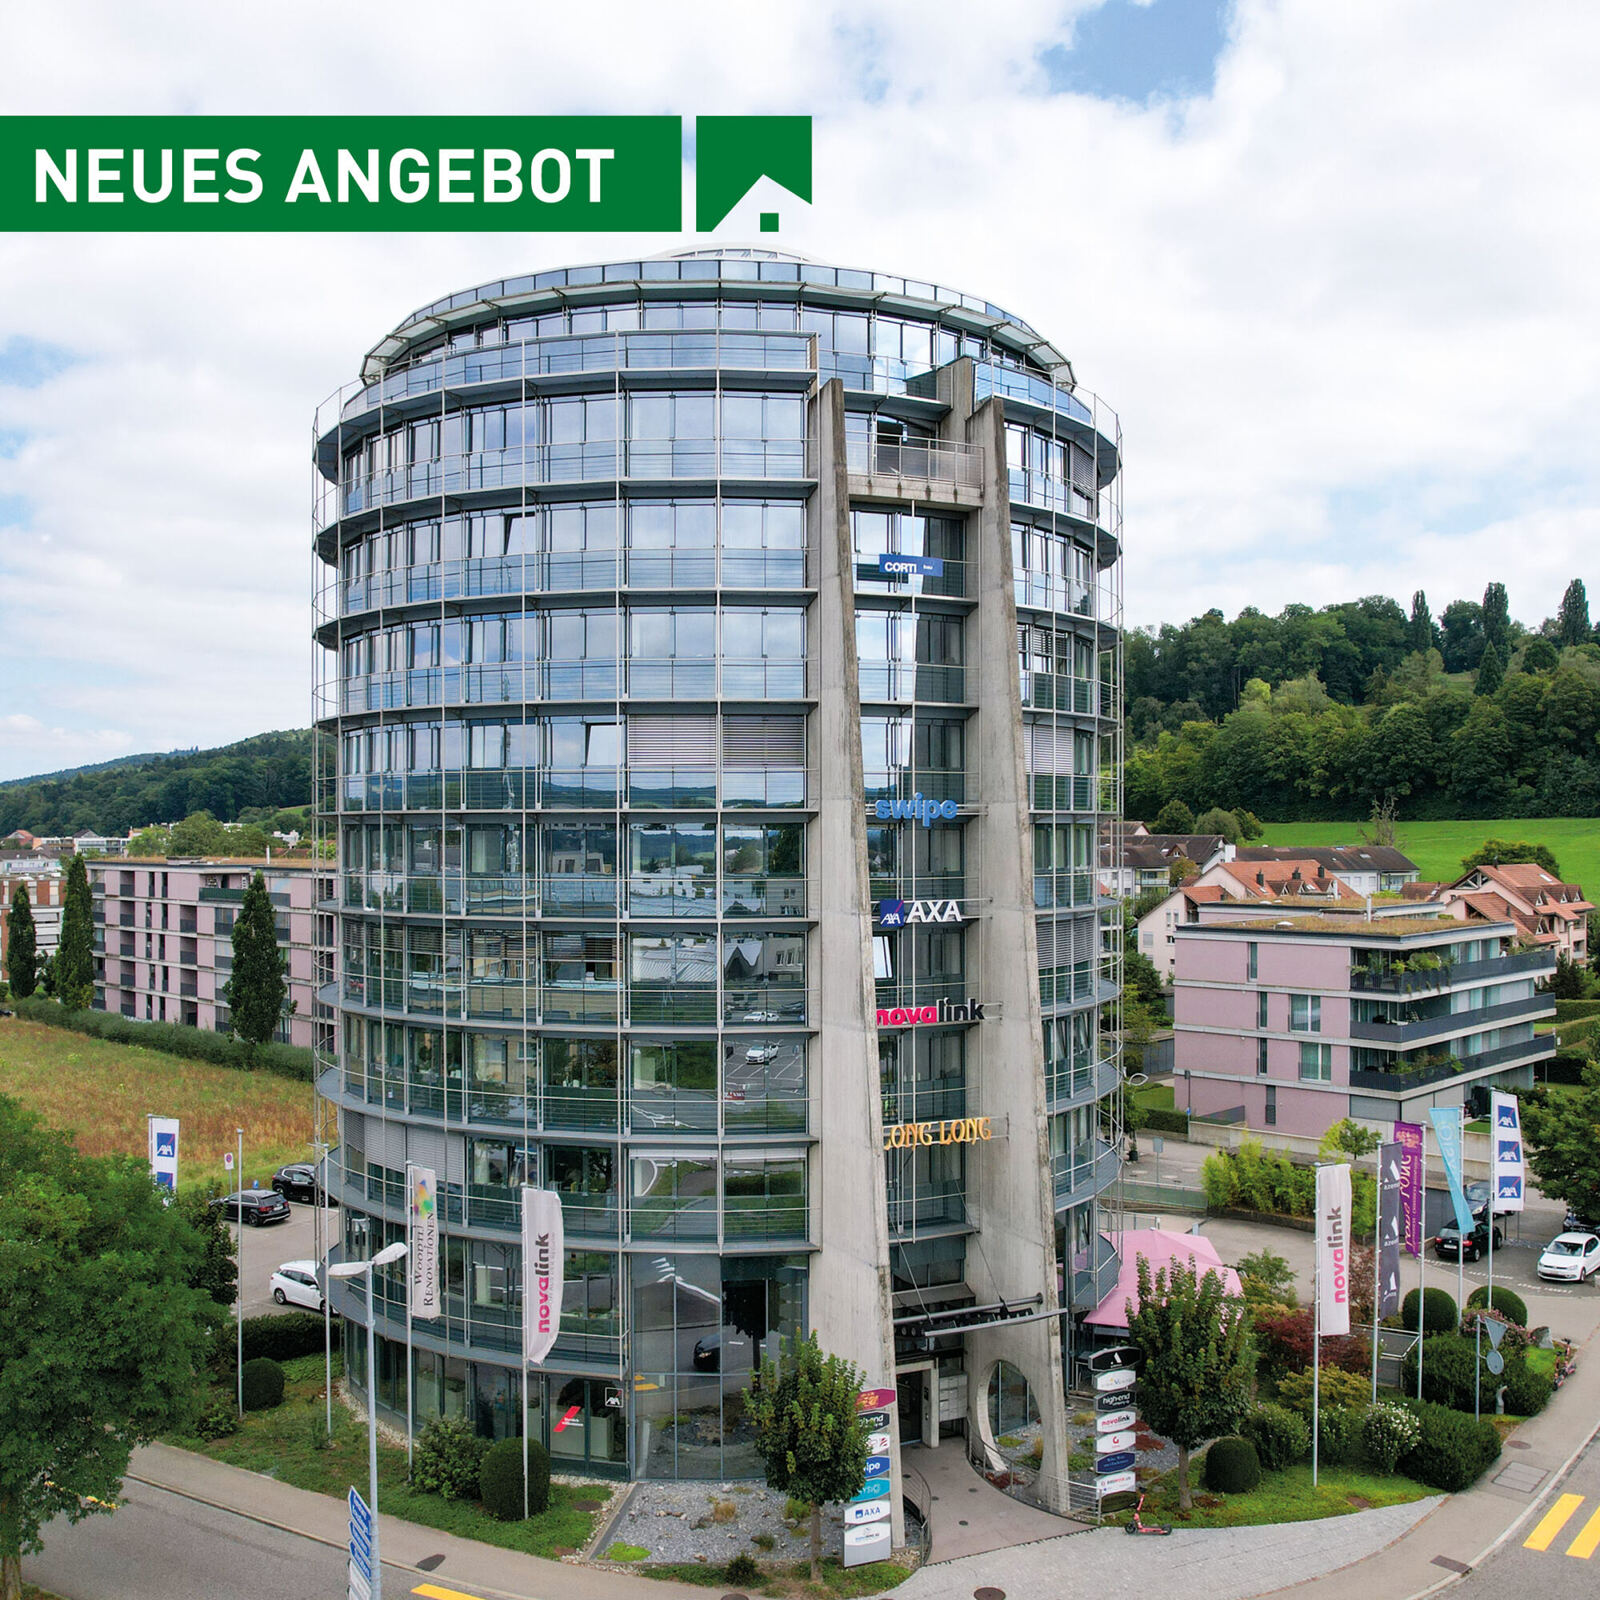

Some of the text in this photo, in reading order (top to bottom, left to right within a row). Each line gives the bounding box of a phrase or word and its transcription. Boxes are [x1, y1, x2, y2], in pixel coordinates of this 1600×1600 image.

[884, 561, 917, 573] CORTI
[875, 791, 958, 828] swipe
[880, 900, 962, 925] AXA AXA
[876, 997, 985, 1026] novalink
[883, 1117, 993, 1151] ONG LONG
[1327, 1206, 1346, 1304] novalink
[534, 1232, 550, 1334] novalink
[1102, 1415, 1130, 1426] novalink
[864, 1506, 880, 1516] AXA
